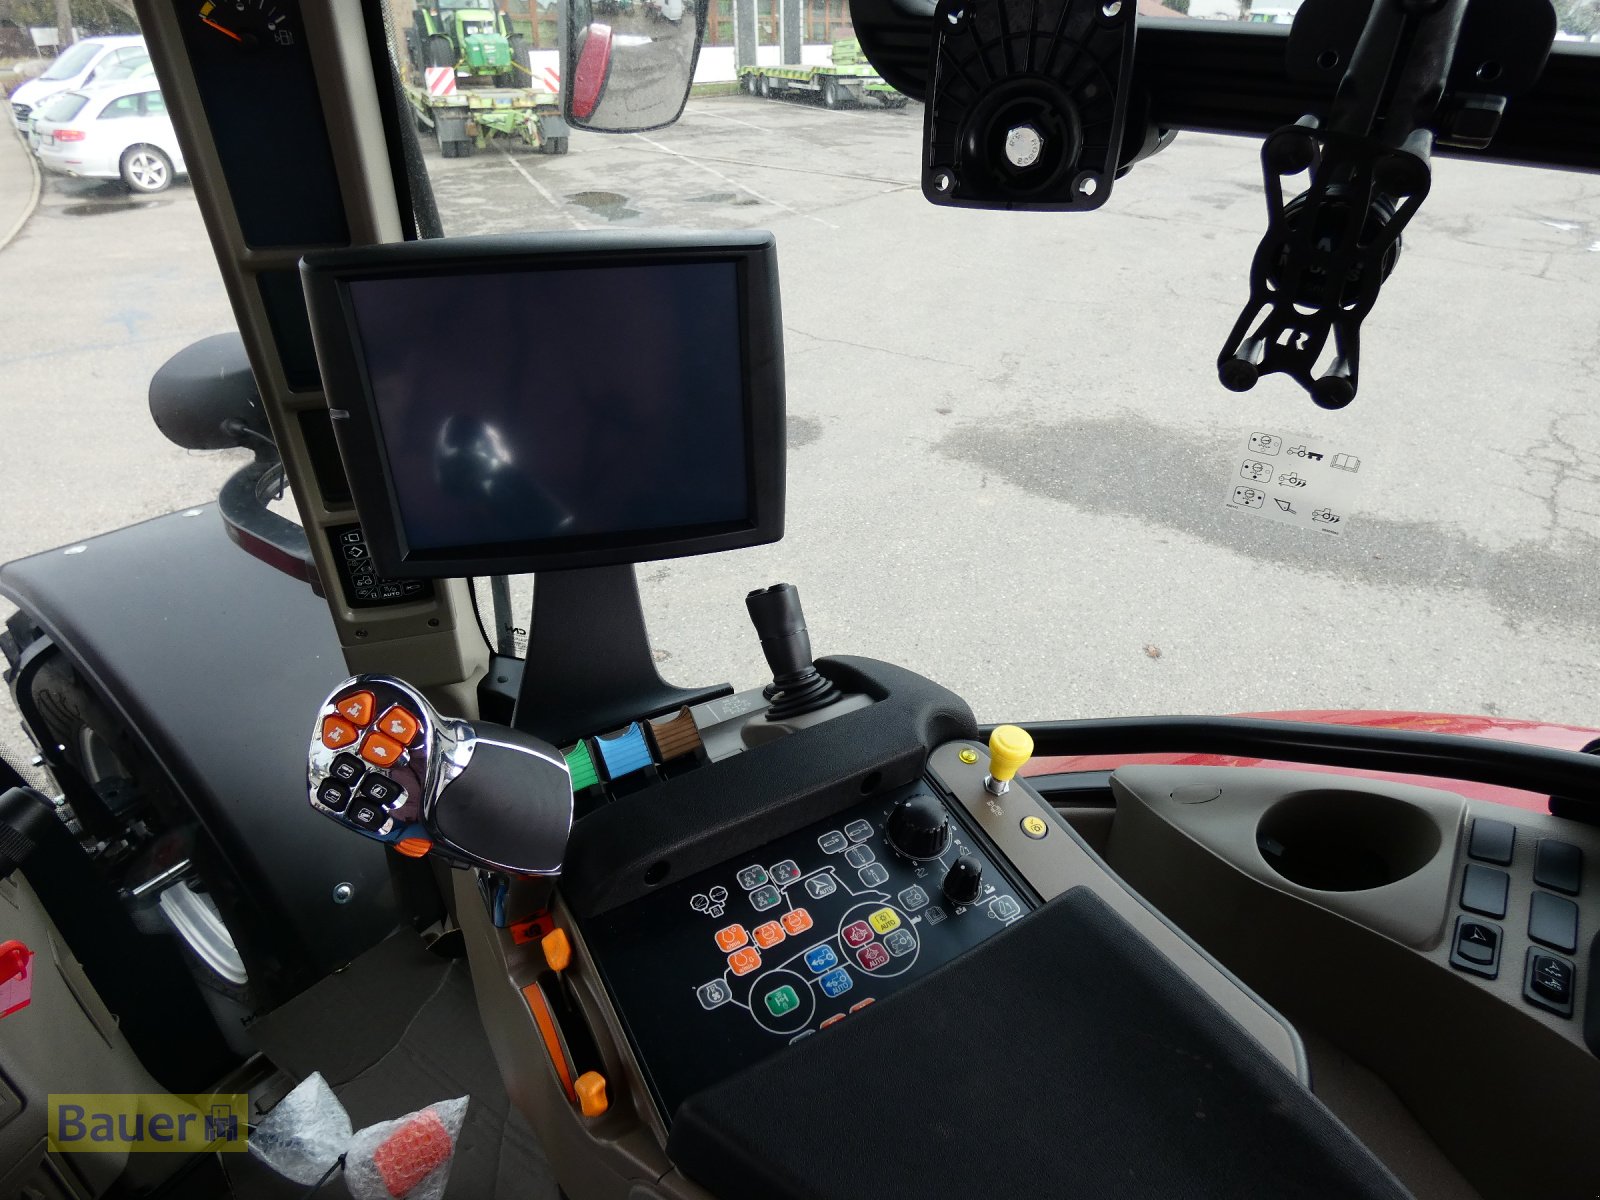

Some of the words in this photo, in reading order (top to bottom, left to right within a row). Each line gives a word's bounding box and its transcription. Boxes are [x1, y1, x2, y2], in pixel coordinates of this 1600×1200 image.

[1276, 328, 1310, 351] R
[819, 886, 834, 896] AUTO
[880, 919, 896, 931] AUTO
[869, 956, 885, 968] AUTO
[832, 982, 849, 996] AUTO
